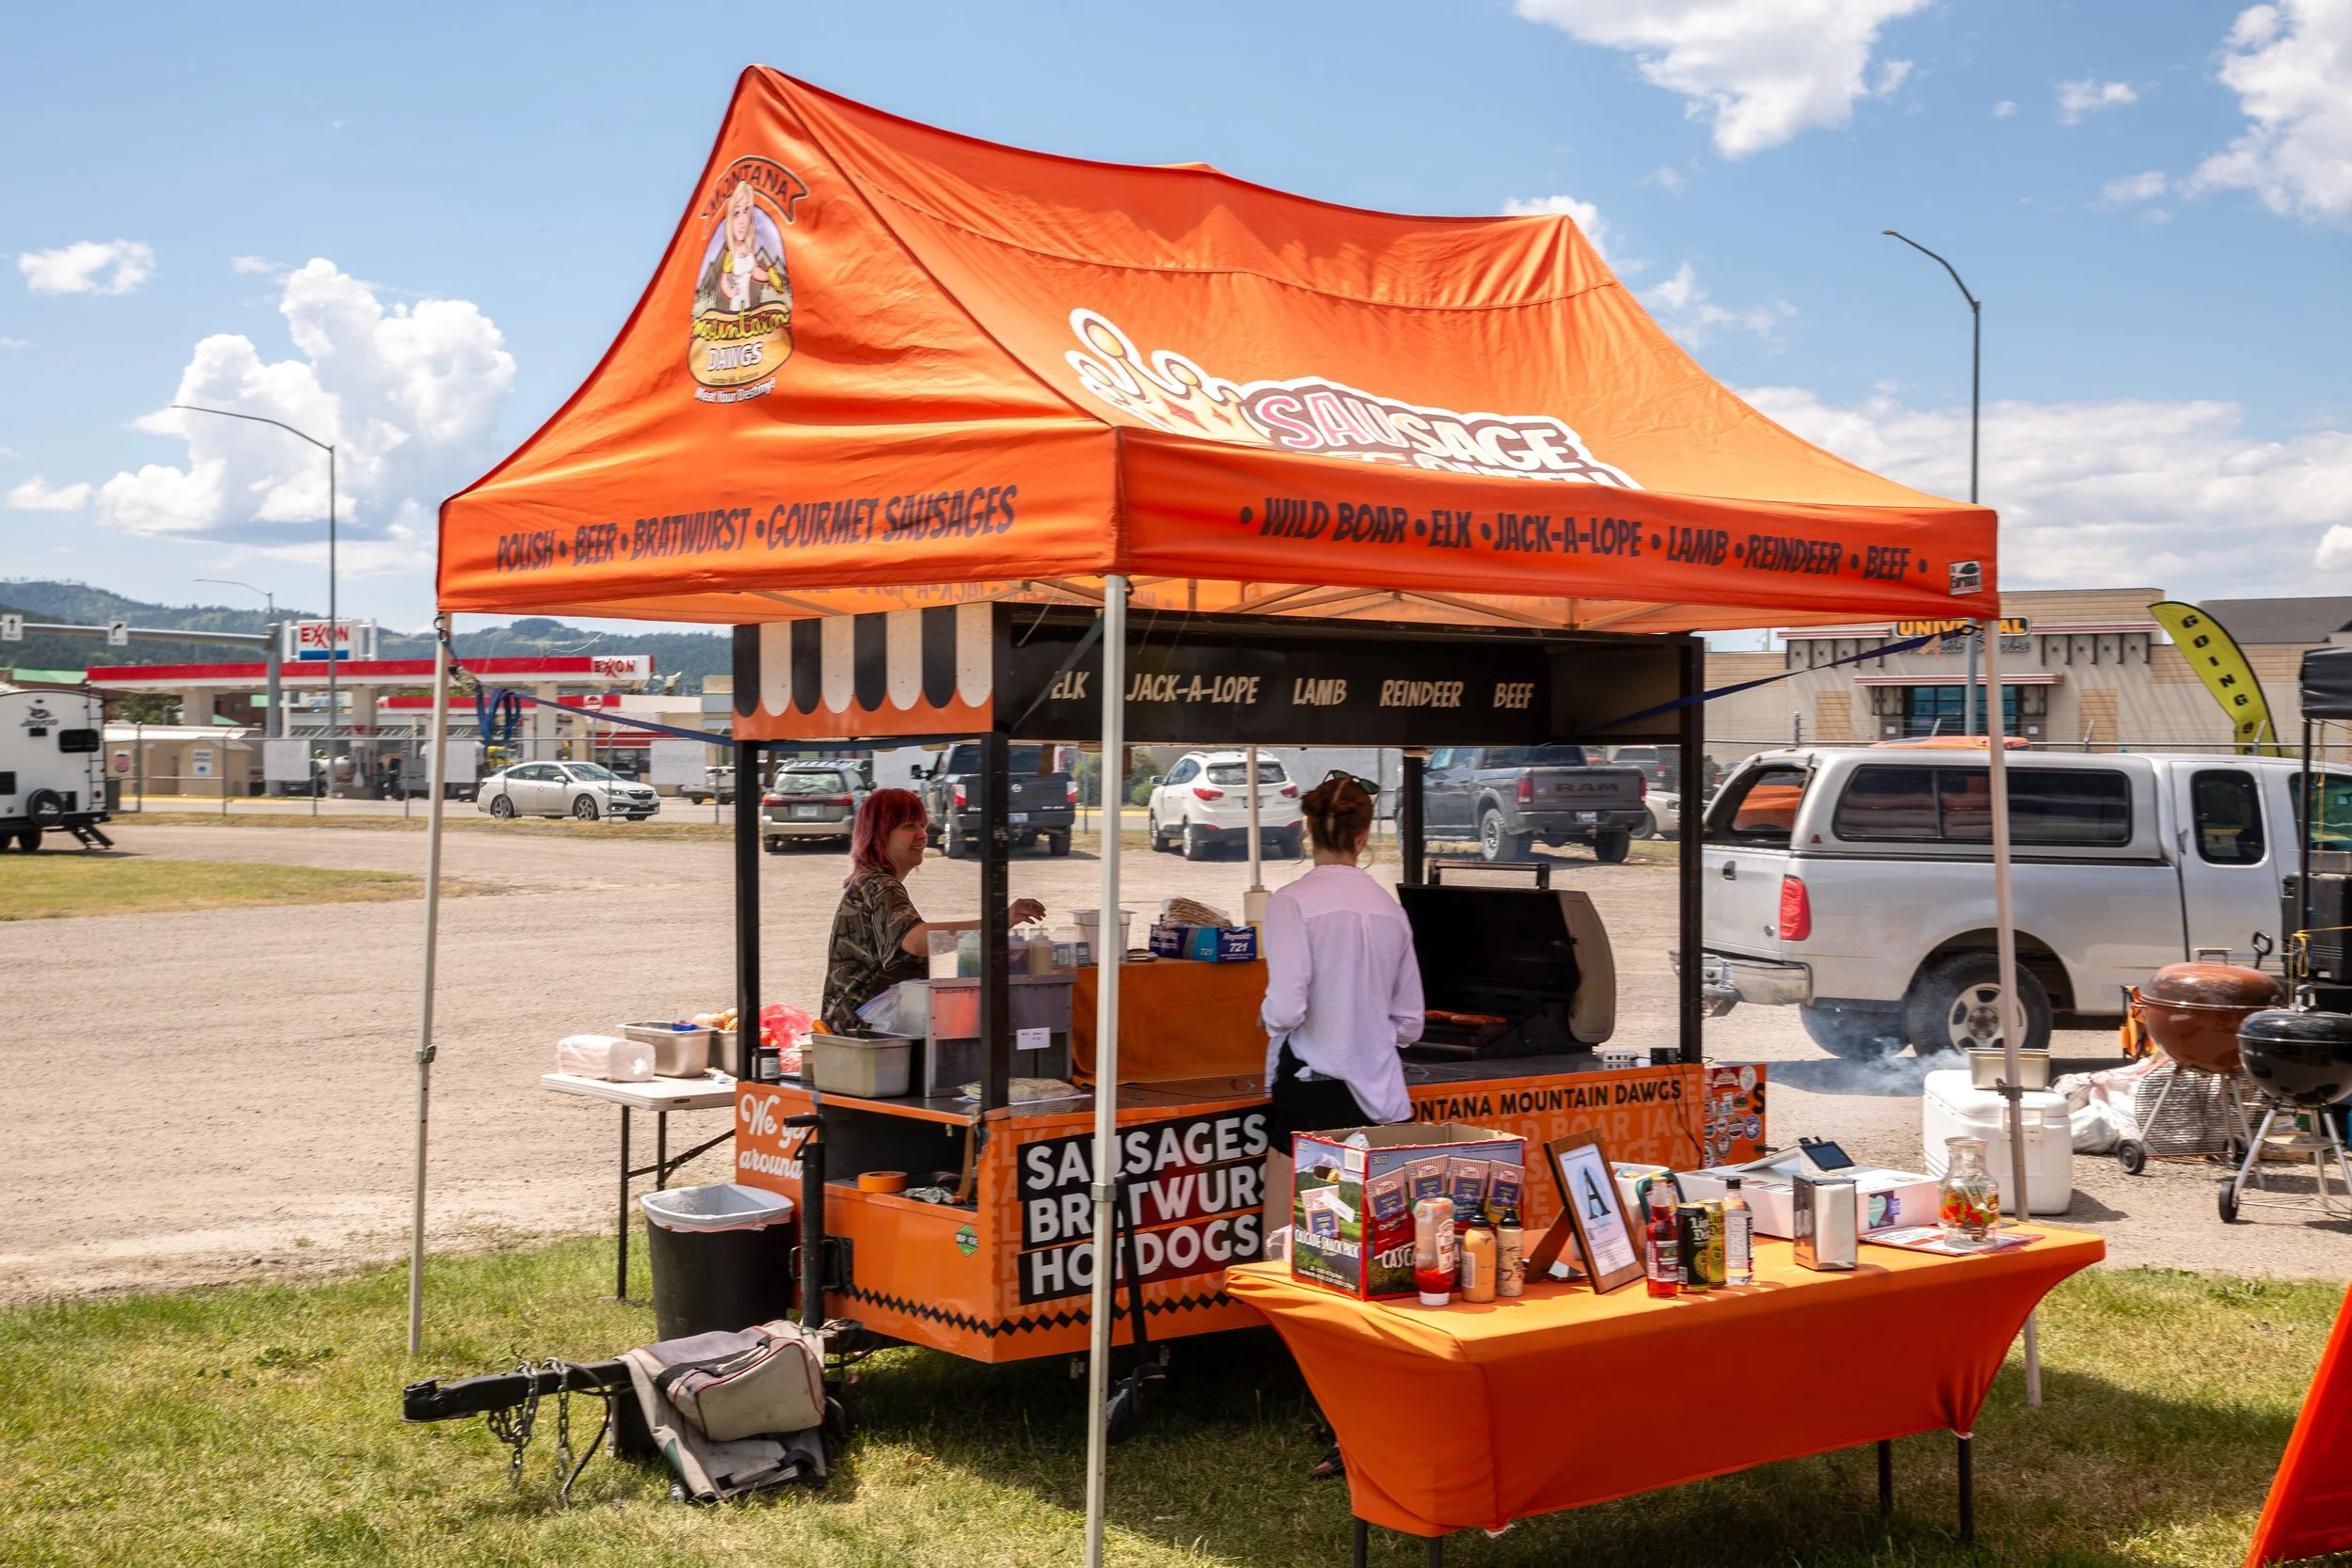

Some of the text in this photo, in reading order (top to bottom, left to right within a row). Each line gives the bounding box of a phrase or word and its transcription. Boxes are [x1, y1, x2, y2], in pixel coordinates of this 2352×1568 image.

[707, 341, 764, 372] DAWGS
[1255, 390, 1583, 472] SAUSAGE
[496, 484, 1018, 573] POLISH BEER BRATWURST GOURMET SAUSAGES
[1260, 498, 1911, 581] WILD BOAR ELK JACK-A-LOPE LAMB REINDEER BEEF
[1899, 619, 2026, 637] UNIVAL
[594, 657, 636, 678] EXXON
[2181, 614, 2249, 706] GOING
[1050, 671, 1534, 709] ELK JACK-A-LOPE LAMB REINDEER BEEF
[1554, 783, 1619, 791] RAM
[1229, 942, 1249, 953] 721
[739, 1093, 810, 1149] We ge
[1410, 1079, 1681, 1123] ONTANA MOUNTAIN DAWGS
[1029, 1164, 1265, 1243] BRTWUR
[1583, 1165, 1612, 1221] A
[1134, 1213, 1261, 1276] DOGS
[1382, 1248, 1416, 1269] CASC
